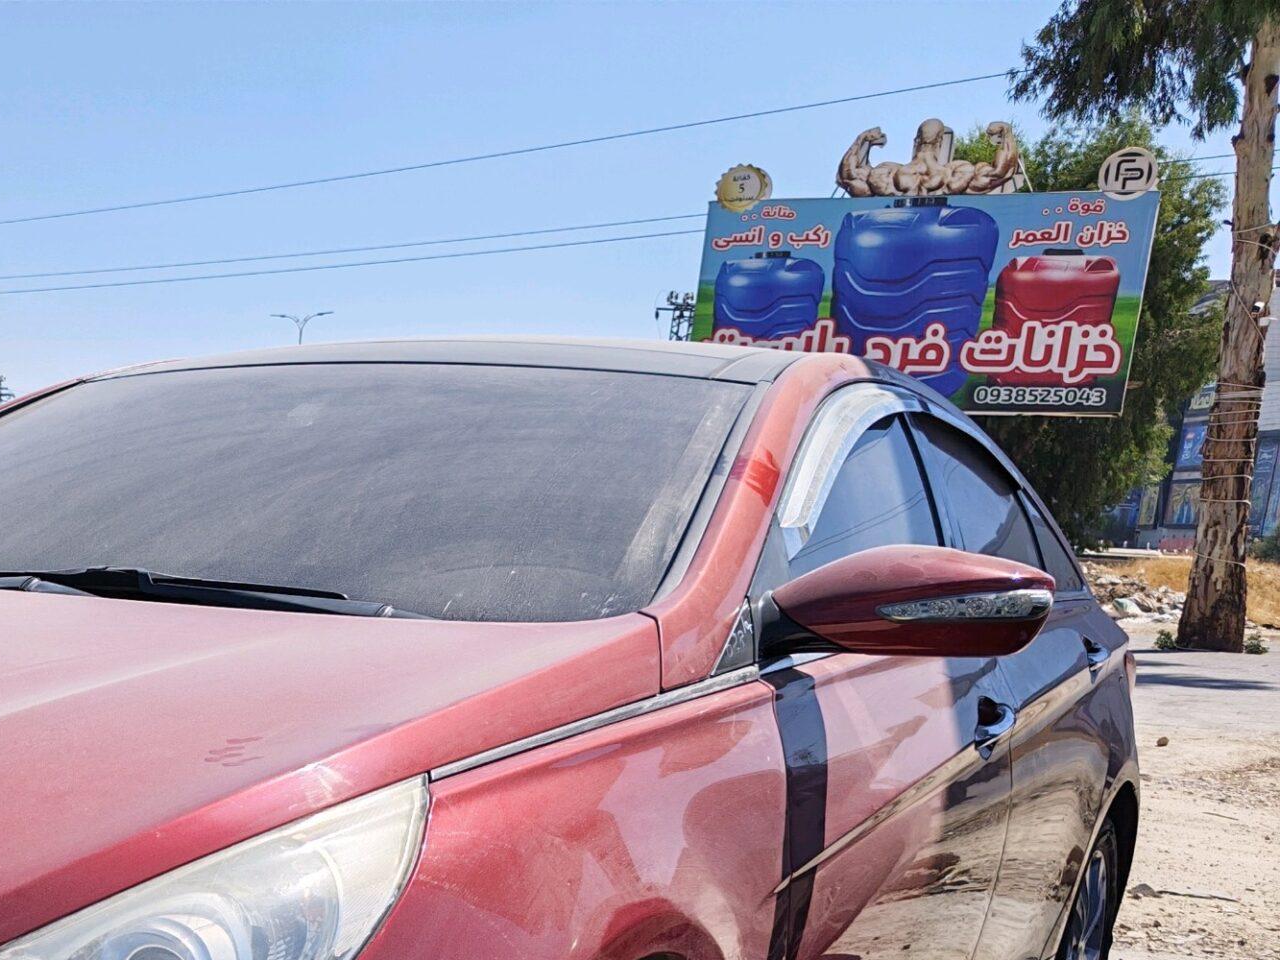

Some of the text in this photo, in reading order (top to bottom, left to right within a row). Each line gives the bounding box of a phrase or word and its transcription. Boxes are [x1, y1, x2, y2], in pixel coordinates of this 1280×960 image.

[738, 182, 745, 194] 5
[761, 205, 797, 219] متانة
[1067, 198, 1106, 216] قوة
[768, 231, 783, 249] و
[787, 224, 832, 249] ركب
[1008, 221, 1130, 249] خزان العمر
[960, 320, 1122, 384] خزانات
[974, 386, 1106, 406] 0938525043
